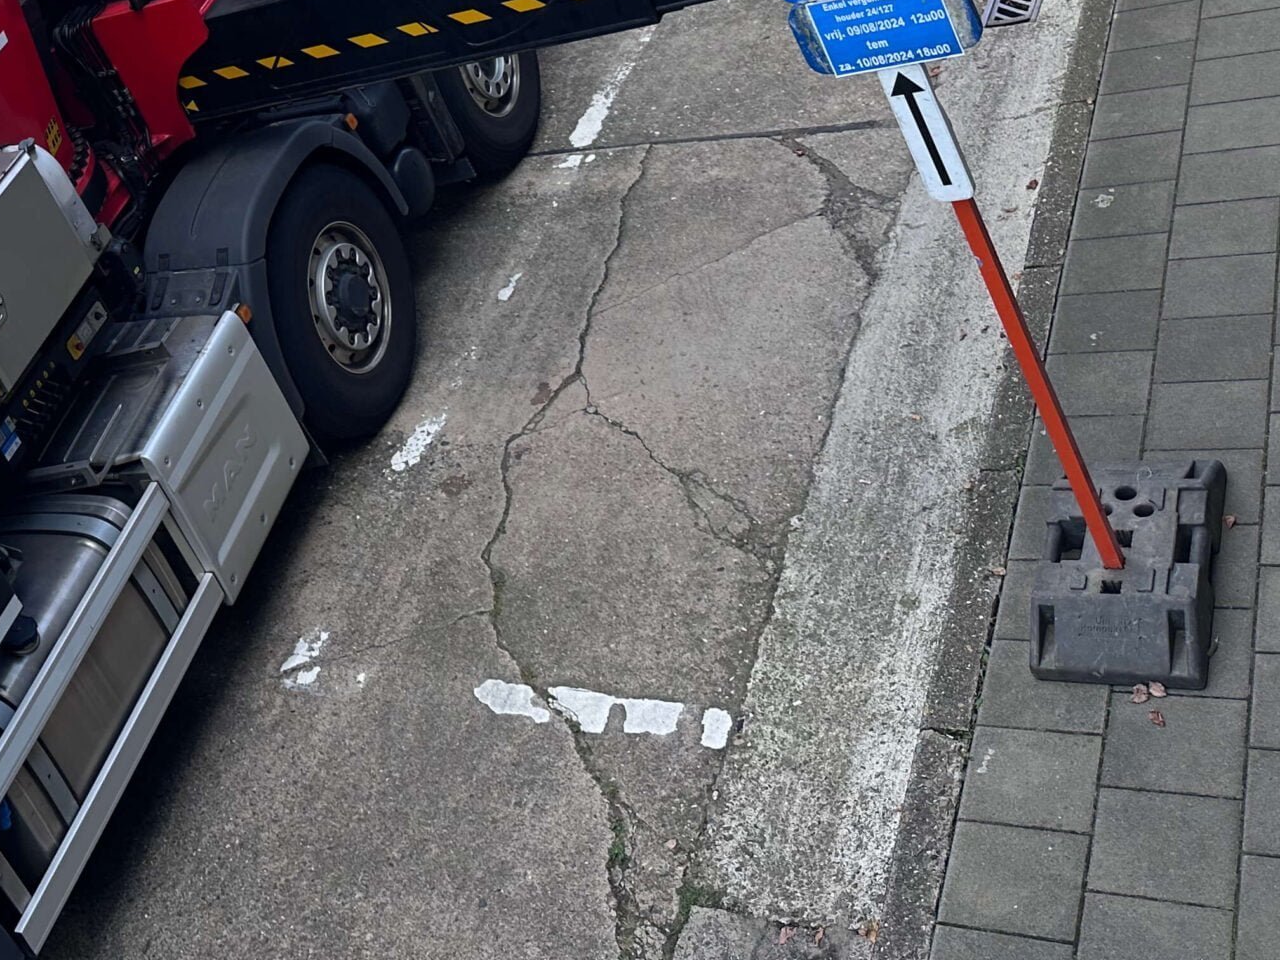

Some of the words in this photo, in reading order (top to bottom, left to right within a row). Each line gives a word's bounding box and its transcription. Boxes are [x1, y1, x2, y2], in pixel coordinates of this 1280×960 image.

[822, 0, 847, 12] Enkel
[834, 11, 865, 23] houder
[865, 4, 894, 17] 24/127
[824, 27, 847, 41] vrij.
[846, 17, 905, 37] 09/08/2024
[910, 8, 946, 25] 12u00
[866, 39, 889, 50] tem
[838, 63, 855, 72] za.
[856, 51, 914, 69] 10/08/2024
[916, 43, 951, 58] 18u00
